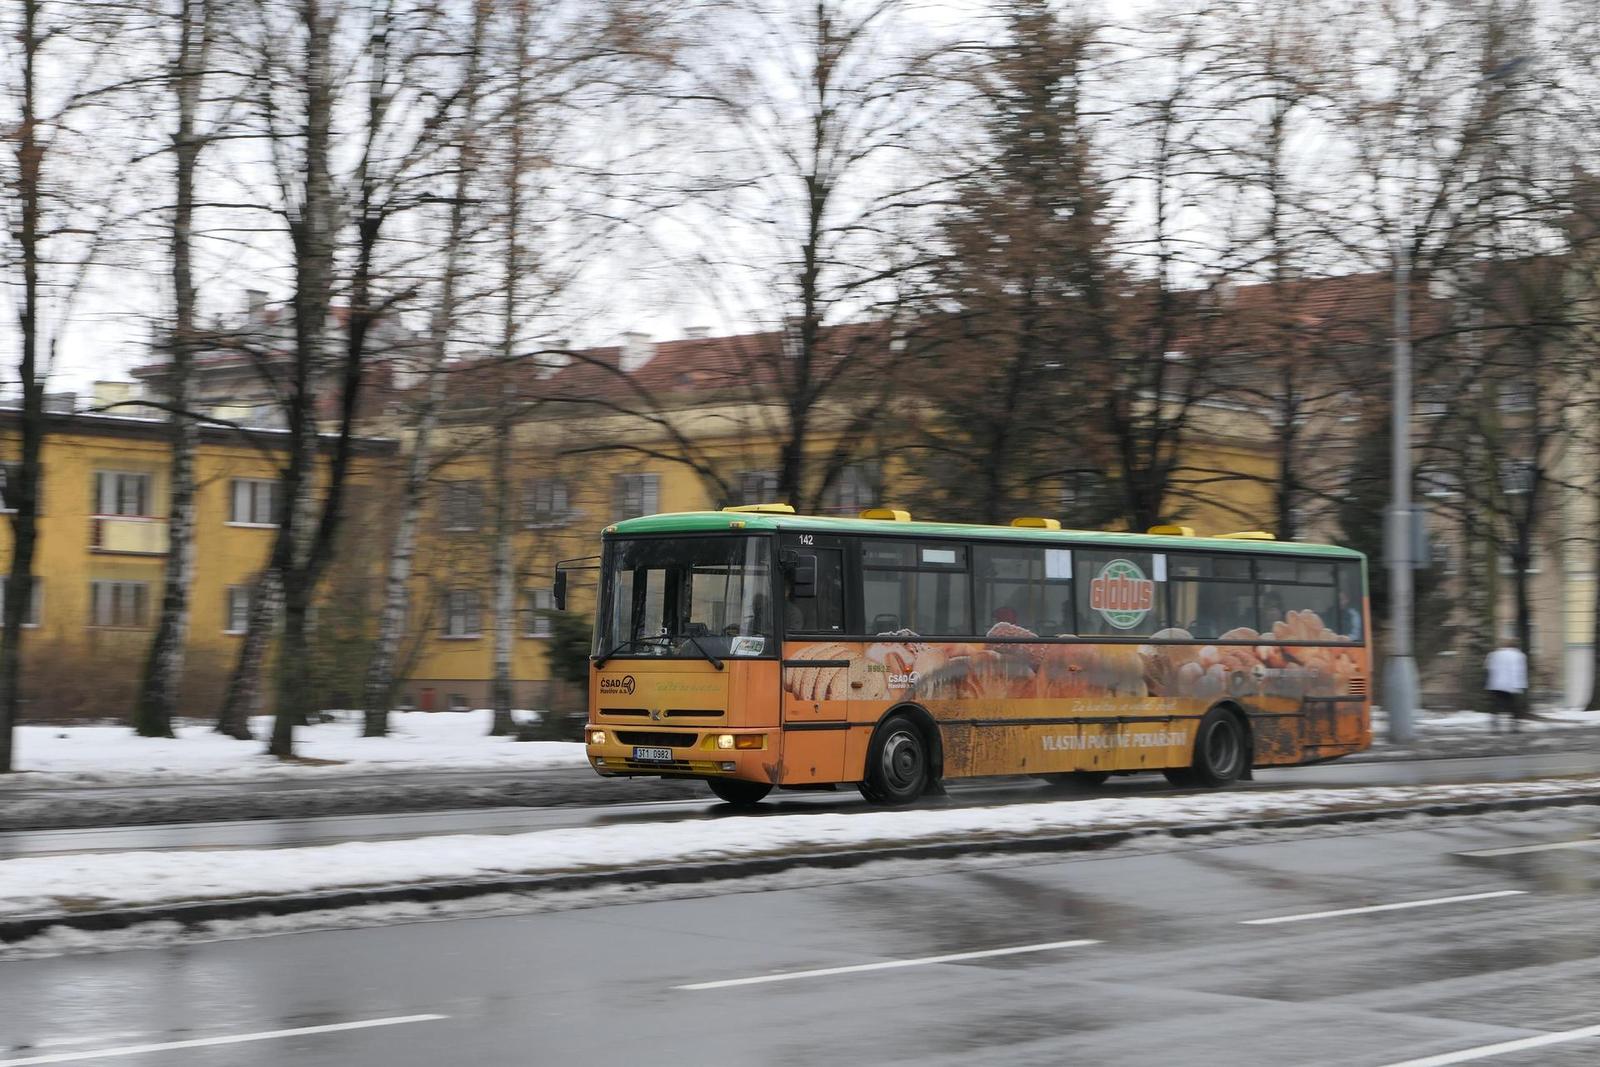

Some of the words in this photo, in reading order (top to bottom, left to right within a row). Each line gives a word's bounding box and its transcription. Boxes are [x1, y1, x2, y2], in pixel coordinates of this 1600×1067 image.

[799, 534, 814, 545] 142
[600, 677, 621, 688] ČSAD
[638, 748, 649, 758] 3T1
[653, 749, 669, 759] 0982
